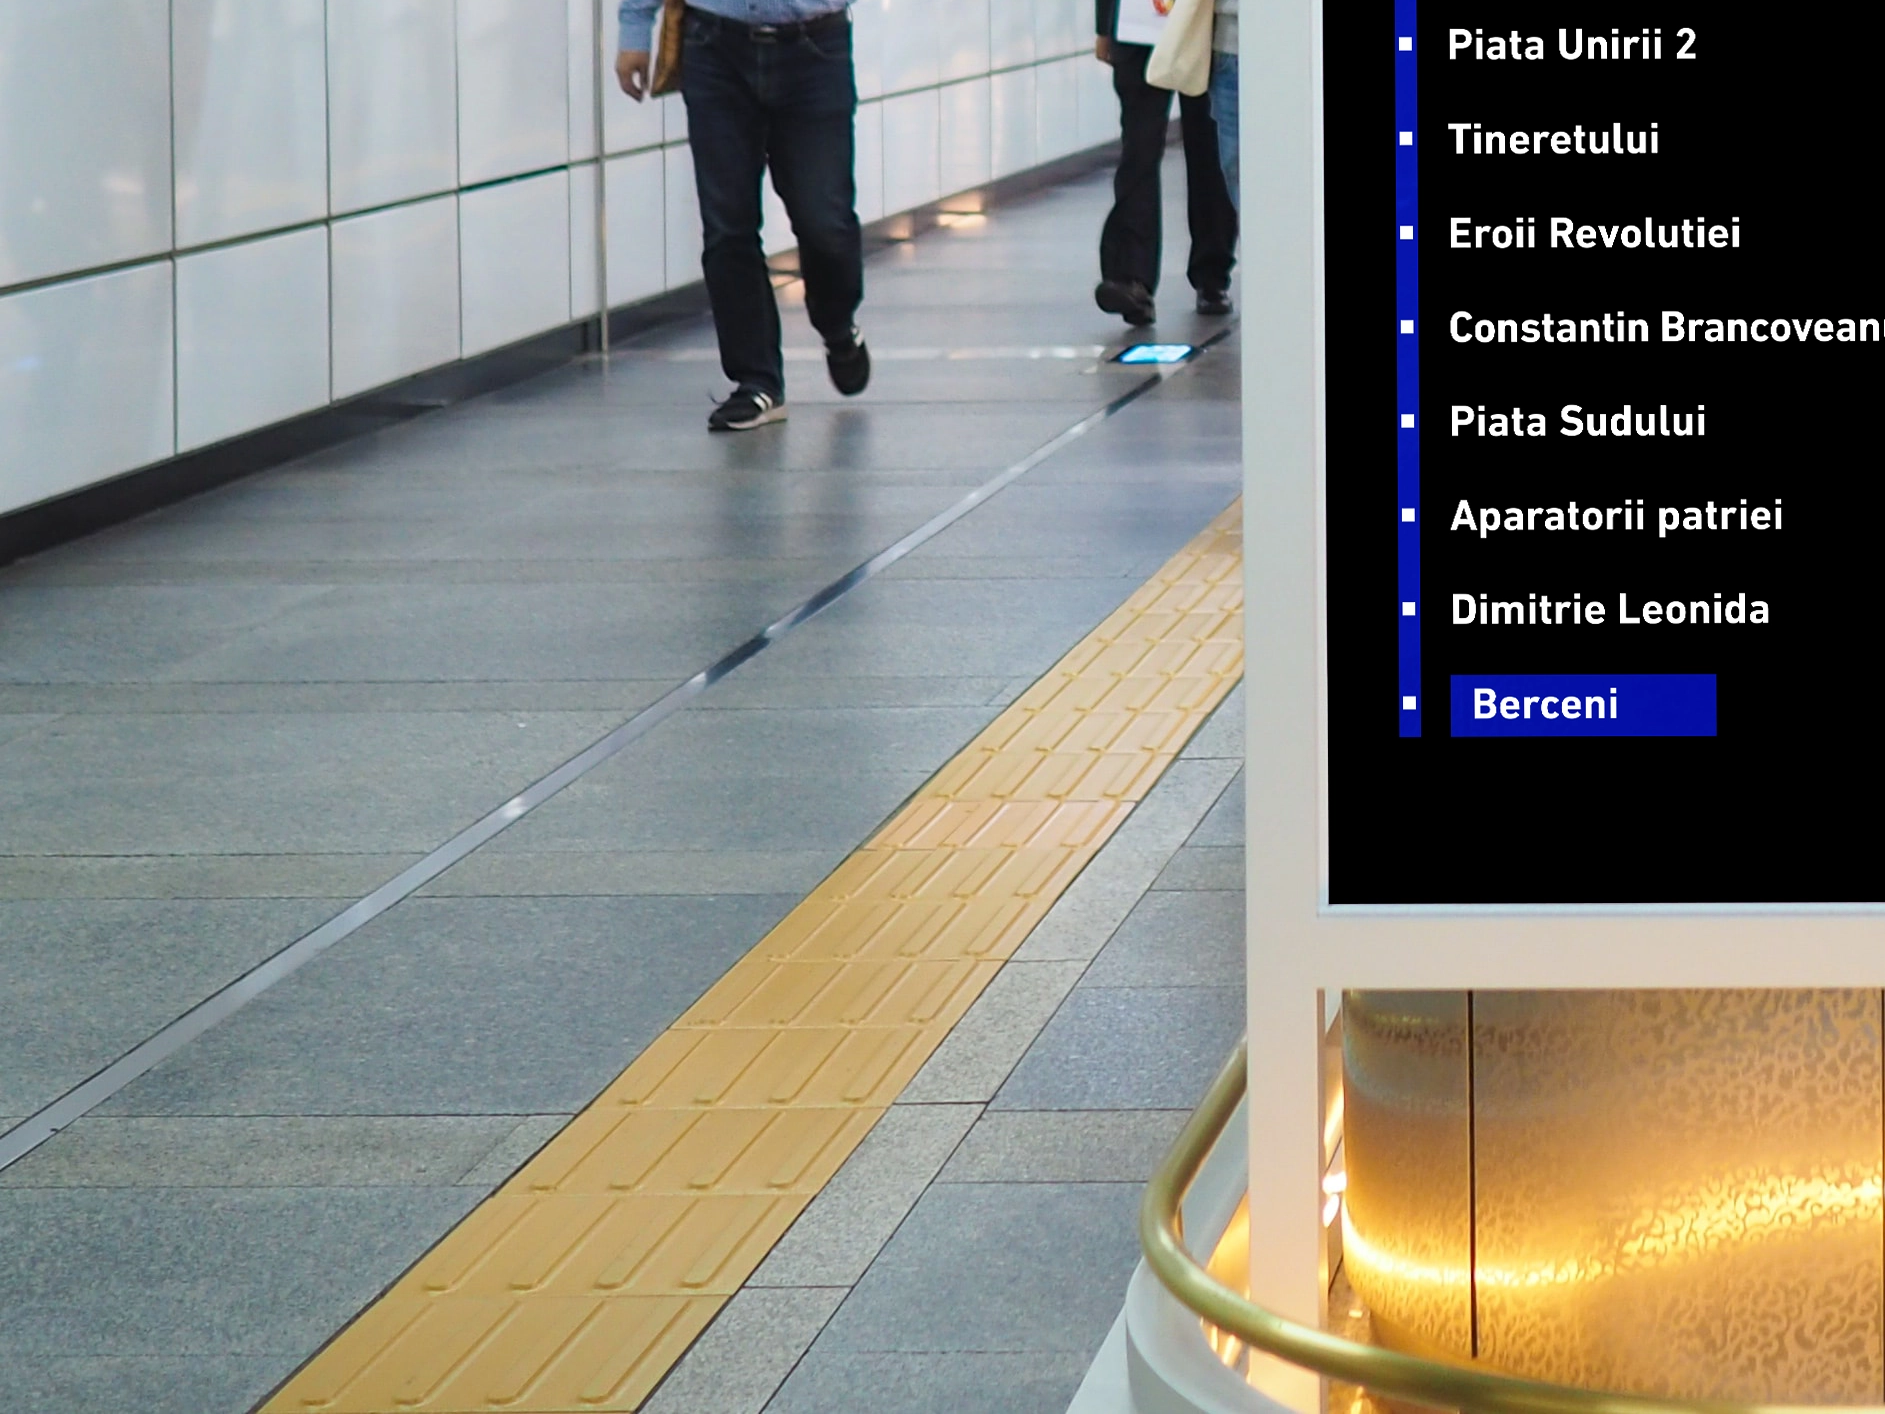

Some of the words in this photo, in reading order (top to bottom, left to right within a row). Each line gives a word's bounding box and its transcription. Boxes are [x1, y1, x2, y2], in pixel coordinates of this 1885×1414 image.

[1449, 28, 1545, 62] Piata
[1558, 28, 1663, 62] Unirii
[1676, 27, 1698, 61] 2
[1448, 122, 1660, 156] Tineretului
[1450, 217, 1536, 250] Eroii
[1550, 216, 1741, 250] Revolutiei
[1449, 310, 1650, 344] Constantin
[1451, 405, 1547, 438] Piata
[1559, 404, 1706, 438] Sudului
[1450, 498, 1645, 539] Aparatorii
[1658, 498, 1783, 539] patriei
[1452, 592, 1607, 626] Dimitrie
[1619, 592, 1770, 626] Leonida
[1473, 687, 1618, 721] Berceni
